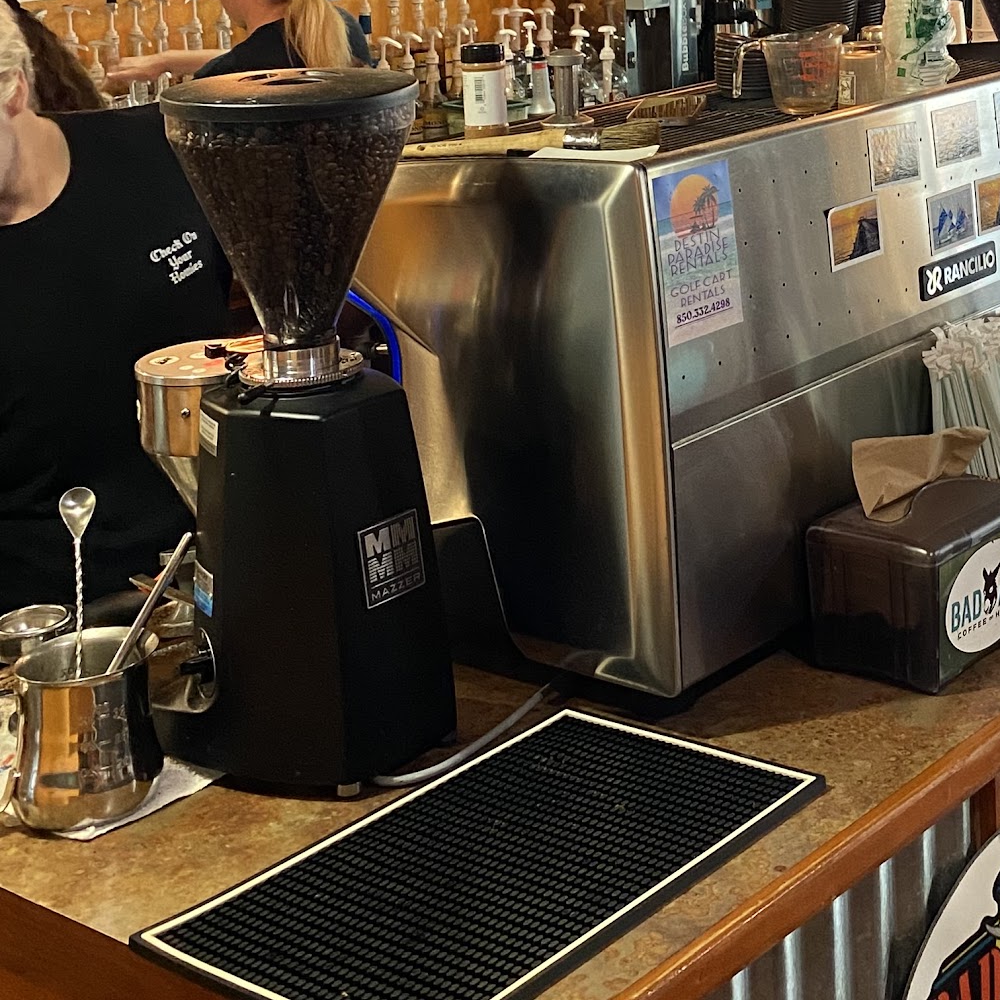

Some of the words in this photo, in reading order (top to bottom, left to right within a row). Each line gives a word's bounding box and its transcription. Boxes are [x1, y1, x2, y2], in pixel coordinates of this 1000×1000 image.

[150, 239, 184, 262] Check
[668, 237, 729, 266] PARADISE
[674, 228, 720, 252] DESTIN
[168, 250, 192, 271] Your
[671, 250, 728, 277] RENTALS
[943, 250, 996, 287] RANCILIO
[670, 280, 700, 298] GOLF
[703, 269, 733, 287] CART
[681, 285, 725, 308] RENTALS
[371, 572, 421, 601] MAZZER
[952, 589, 981, 633] BAD
[957, 618, 987, 641] COFFEE
